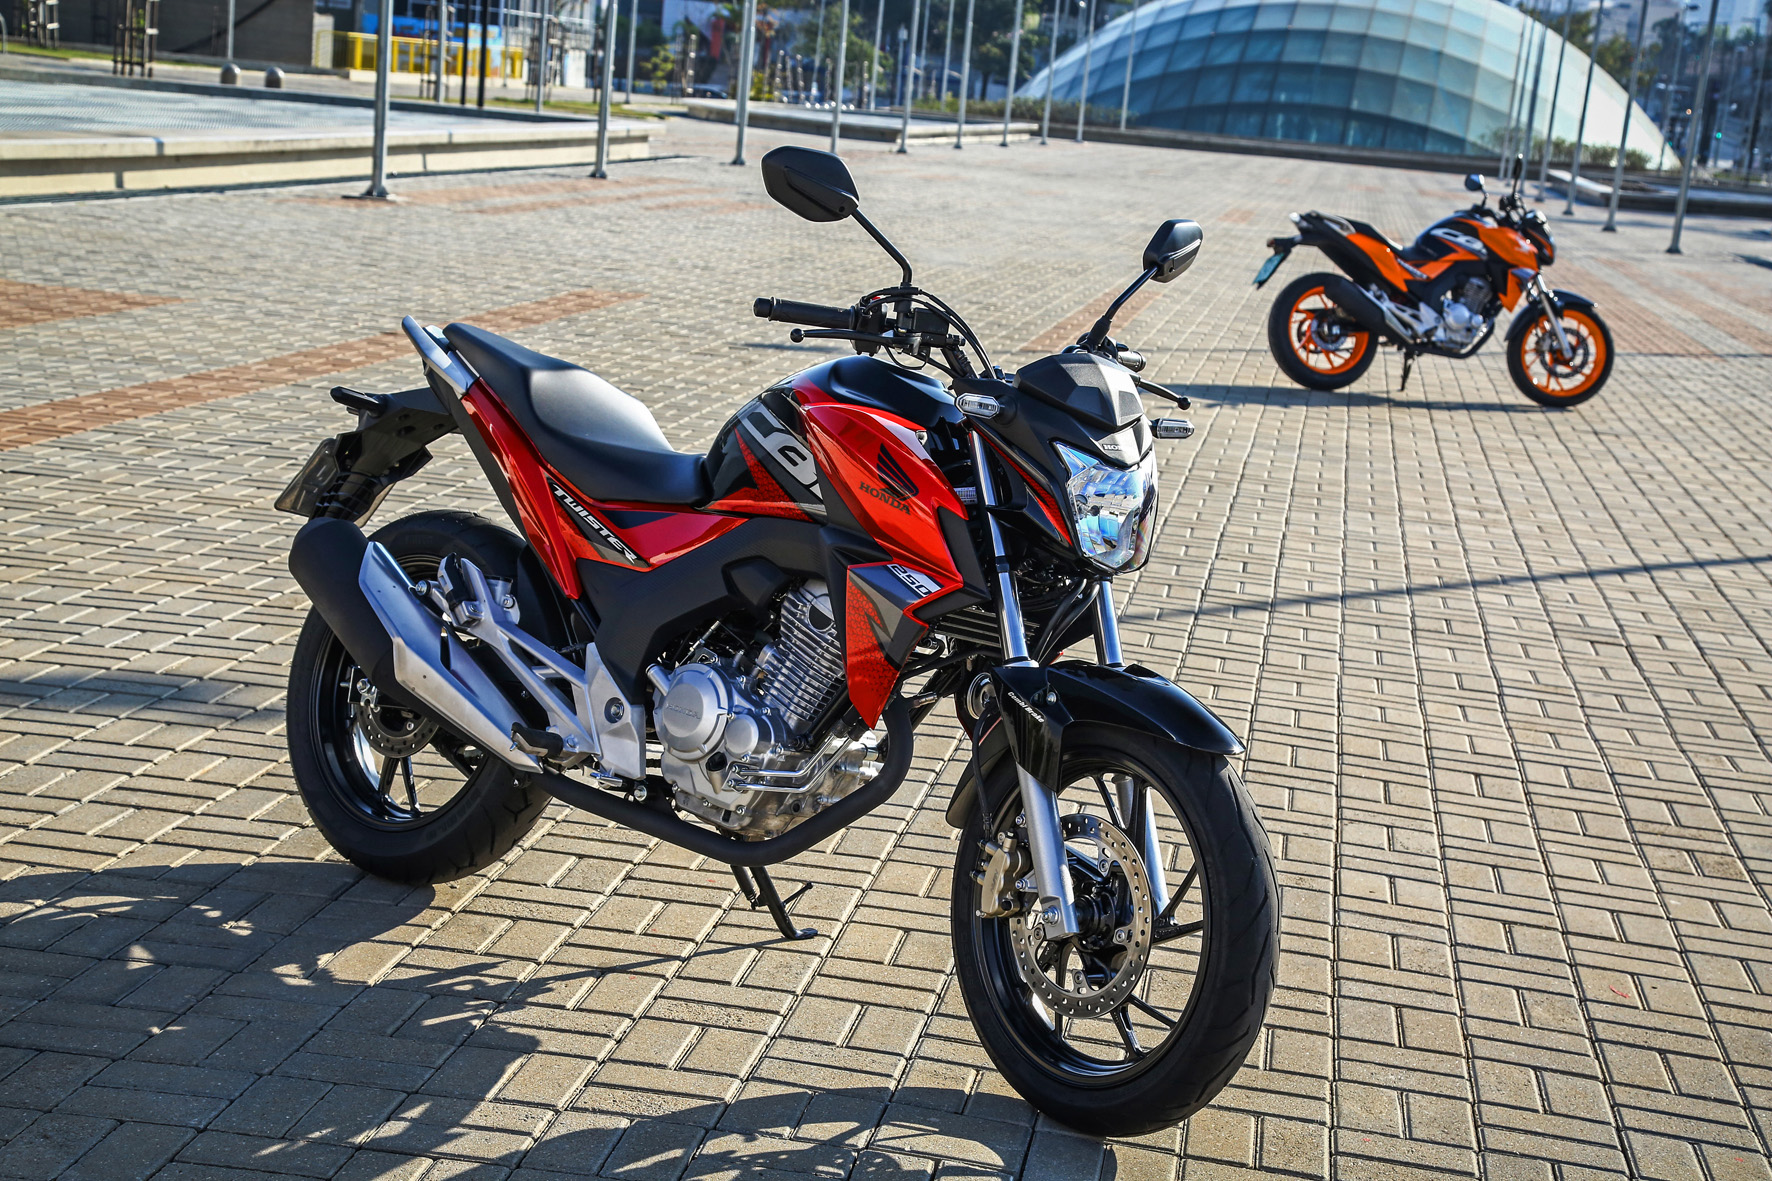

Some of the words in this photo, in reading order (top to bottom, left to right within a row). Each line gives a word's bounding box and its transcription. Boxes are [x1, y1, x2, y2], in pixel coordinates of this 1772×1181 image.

[859, 481, 912, 515] HONDA
[552, 483, 638, 565] TWISTER
[890, 564, 933, 597] 250
[1008, 691, 1028, 708] Combi
[1025, 706, 1045, 723] Brake
